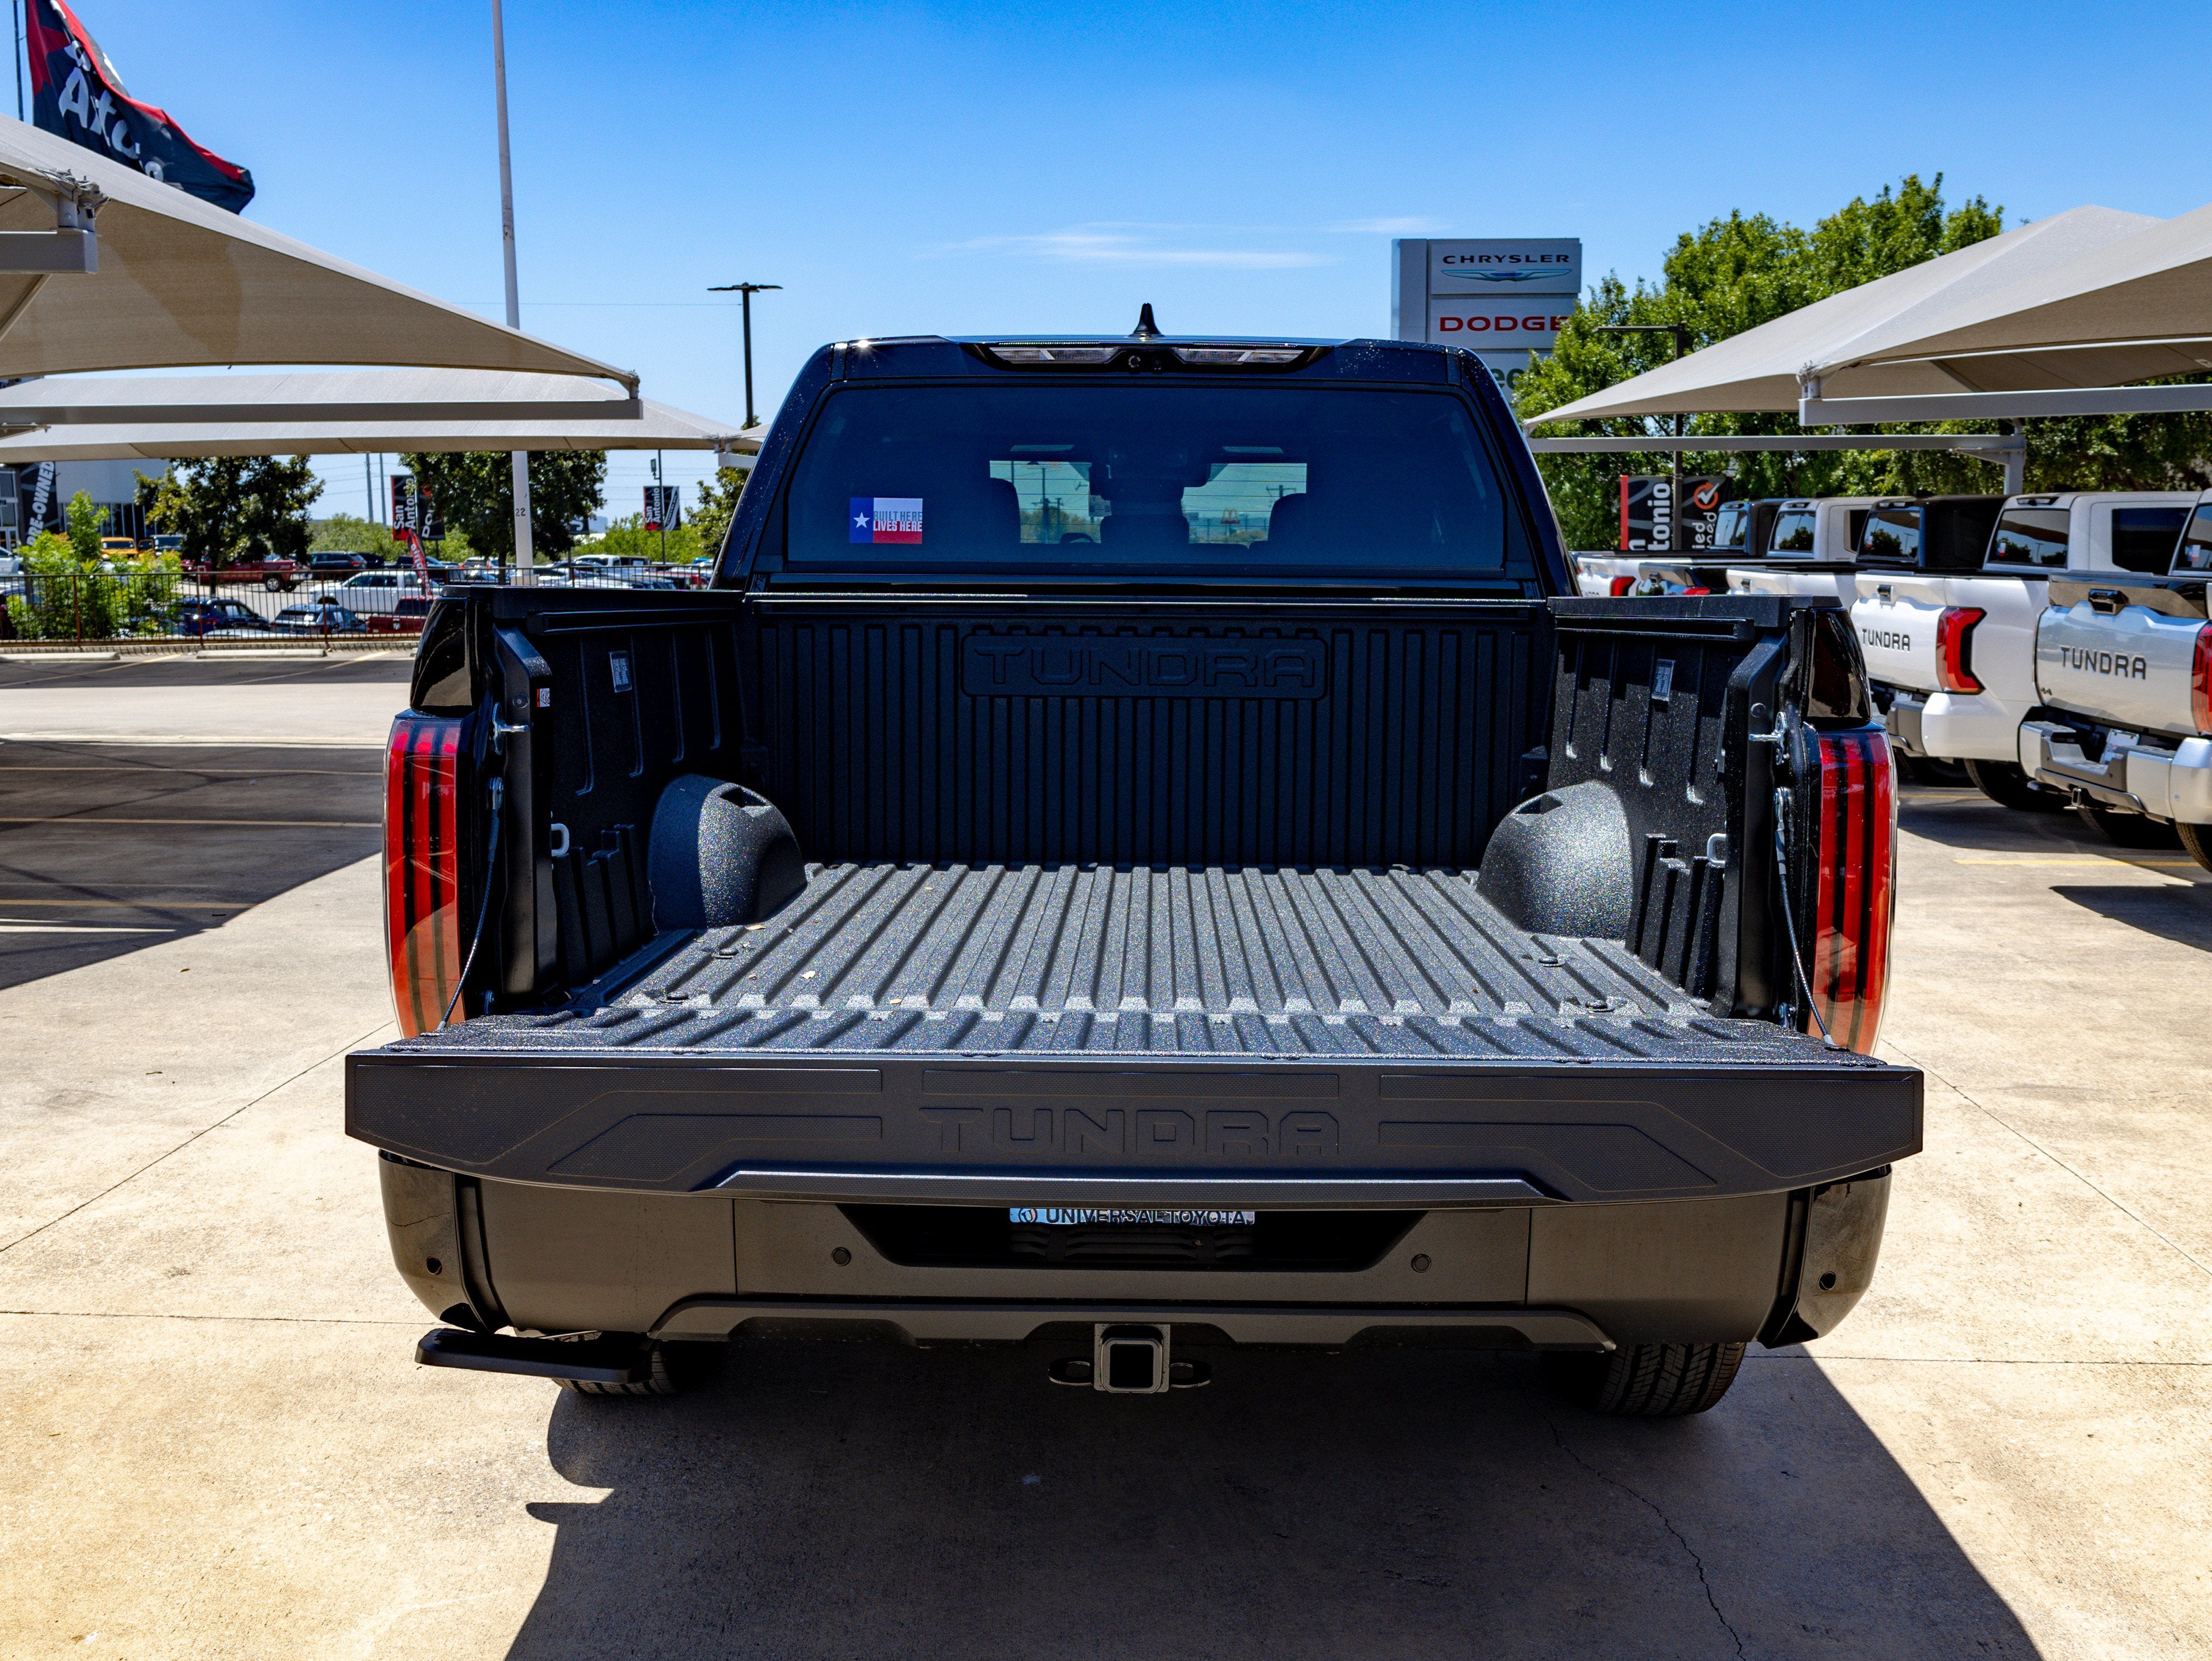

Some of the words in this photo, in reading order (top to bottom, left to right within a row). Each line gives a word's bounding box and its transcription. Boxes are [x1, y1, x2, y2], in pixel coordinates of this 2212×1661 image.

[1442, 254, 1570, 264] CHRYSLER
[393, 505, 404, 529] San
[515, 508, 526, 517] 22
[652, 487, 661, 523] Antonio
[873, 510, 898, 521] BUILT
[900, 511, 923, 521] HERE
[1647, 483, 1671, 551] tonio
[873, 520, 897, 531] LIVES
[899, 521, 922, 532] HERE
[1862, 628, 1911, 652] TUNDRA
[974, 646, 1315, 687] TUNDRA
[2061, 646, 2147, 680] TUNDRA
[918, 1107, 1340, 1155] TUNDRA
[1046, 1209, 1164, 1223] UNIVERSAL
[1165, 1210, 1248, 1225] TOYOTA
